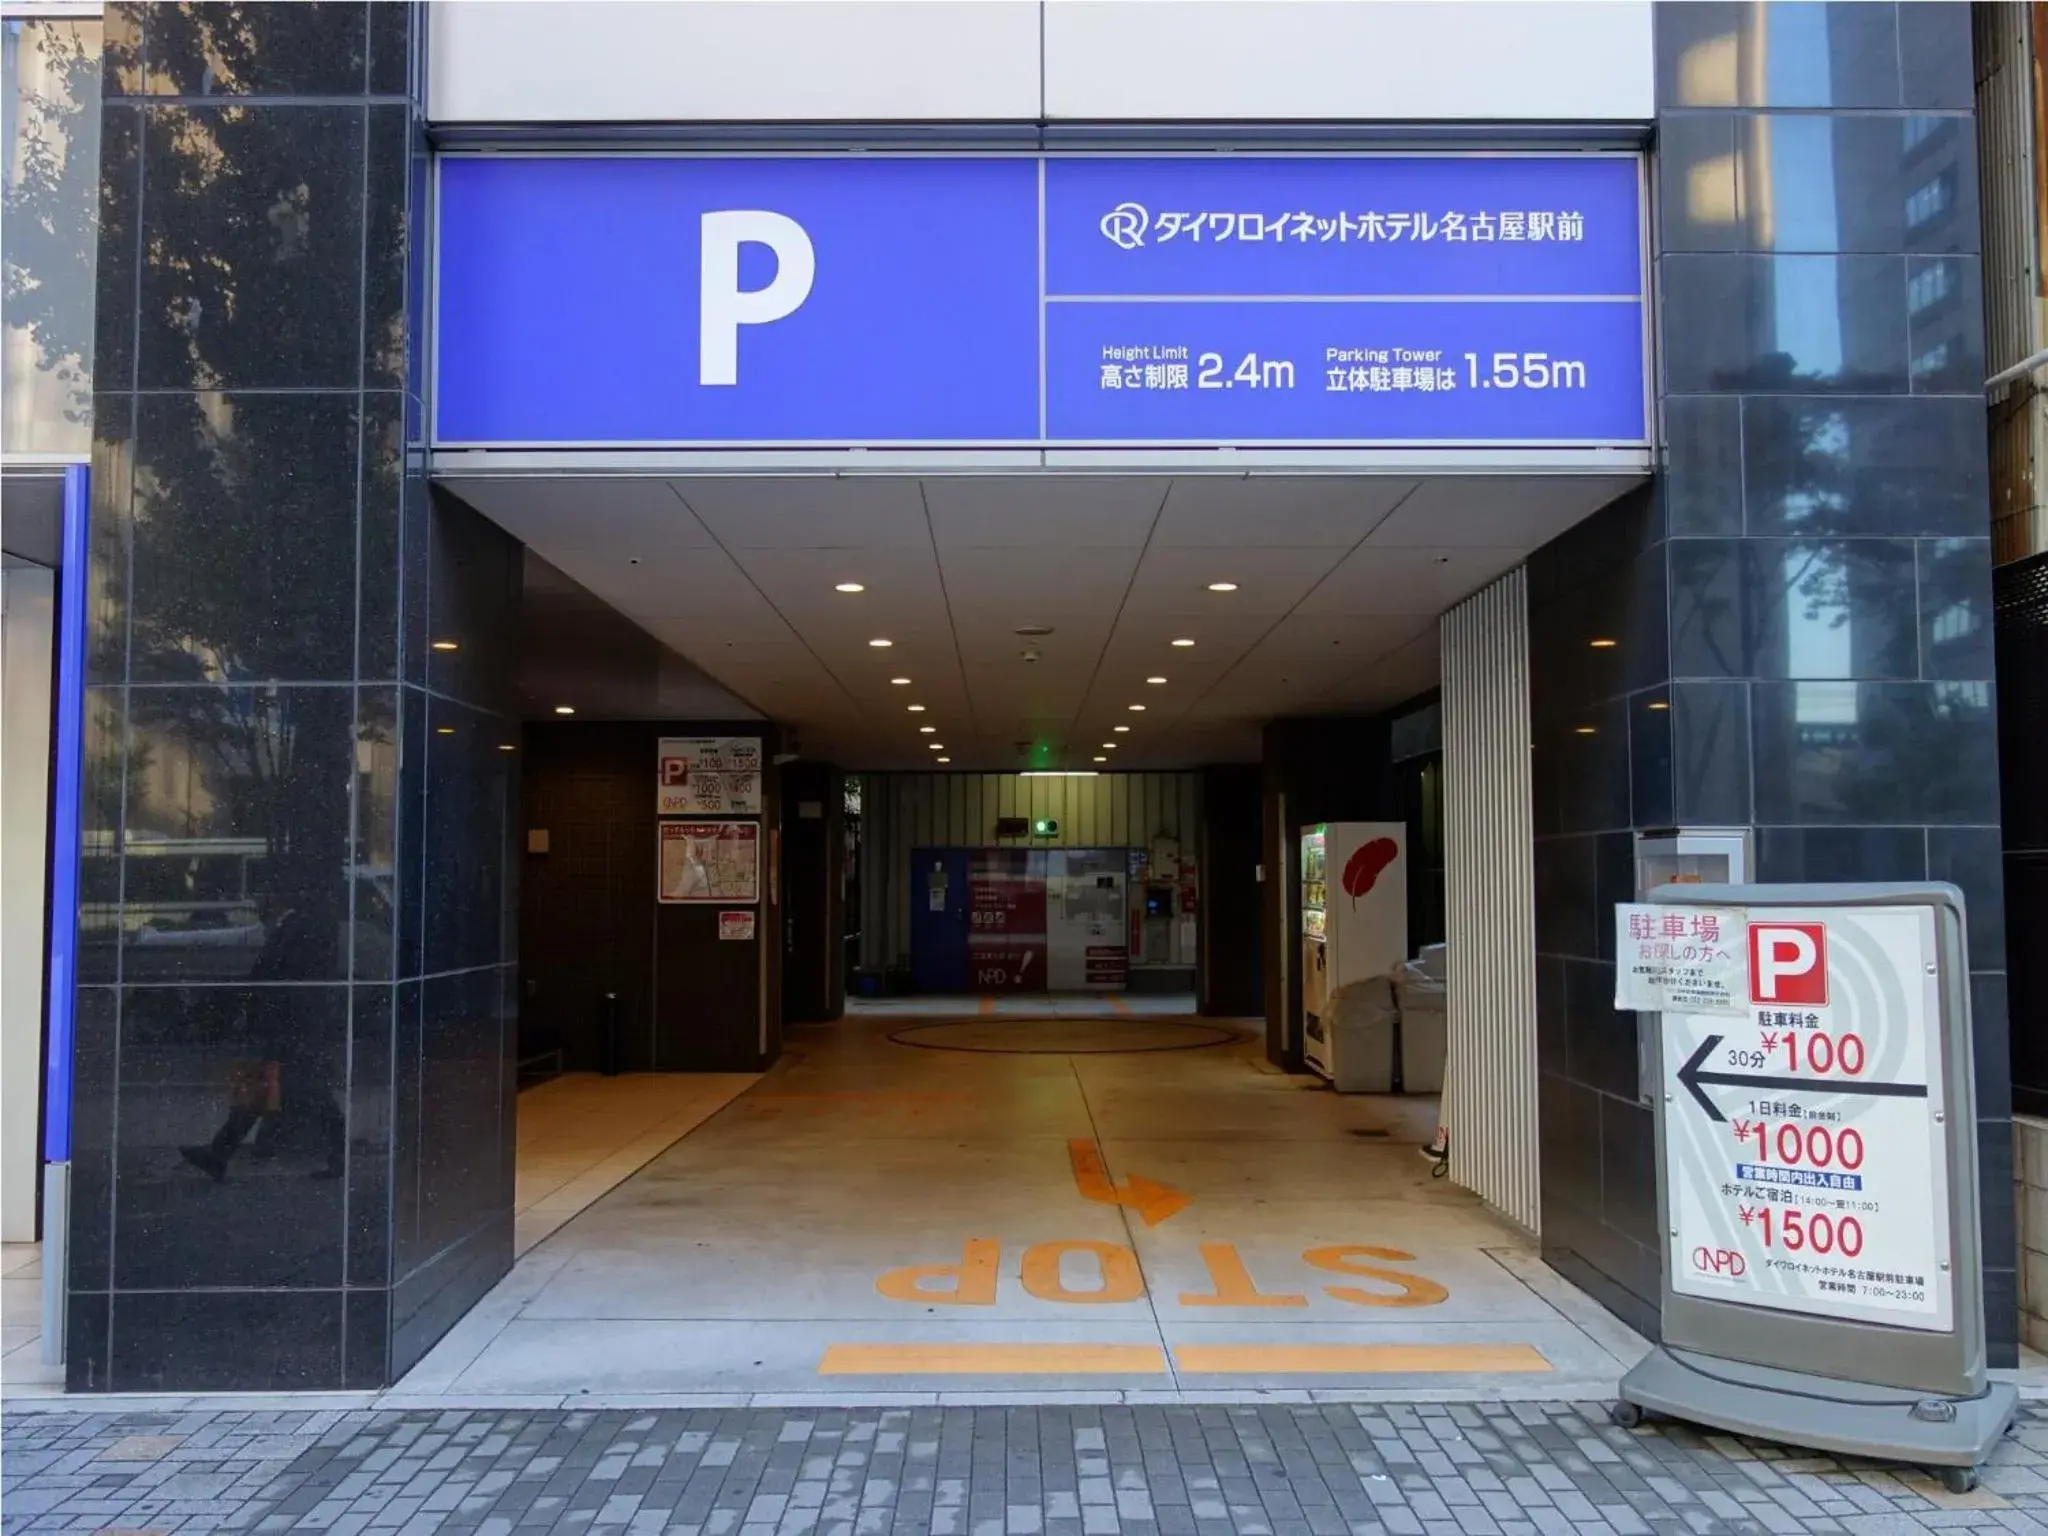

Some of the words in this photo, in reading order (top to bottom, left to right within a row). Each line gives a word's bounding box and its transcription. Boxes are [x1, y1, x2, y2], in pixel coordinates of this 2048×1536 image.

[1154, 210, 1585, 243] ダイワロイネットホテル名古屋駅前
[700, 210, 816, 386] P
[1100, 363, 1189, 390] 高さ制限
[1198, 352, 1295, 389] 2.4m
[1102, 346, 1150, 361] Height
[1153, 346, 1189, 360] Limit
[1326, 347, 1389, 363] Parking
[1392, 347, 1442, 362] Tower
[1326, 366, 1456, 392] 立体駐車場は
[1464, 352, 1586, 389] 1.55m
[665, 760, 685, 785] P
[1628, 913, 1720, 943] 駐車場
[1757, 928, 1817, 999] P
[1758, 1011, 1820, 1030] 駐車料金
[1728, 1049, 1766, 1069] 30分
[1760, 1031, 1865, 1076] ¥100
[1733, 1118, 1864, 1170] ¥1000
[1738, 1203, 1864, 1258] ¥1500
[876, 1237, 1450, 1308] STOP
